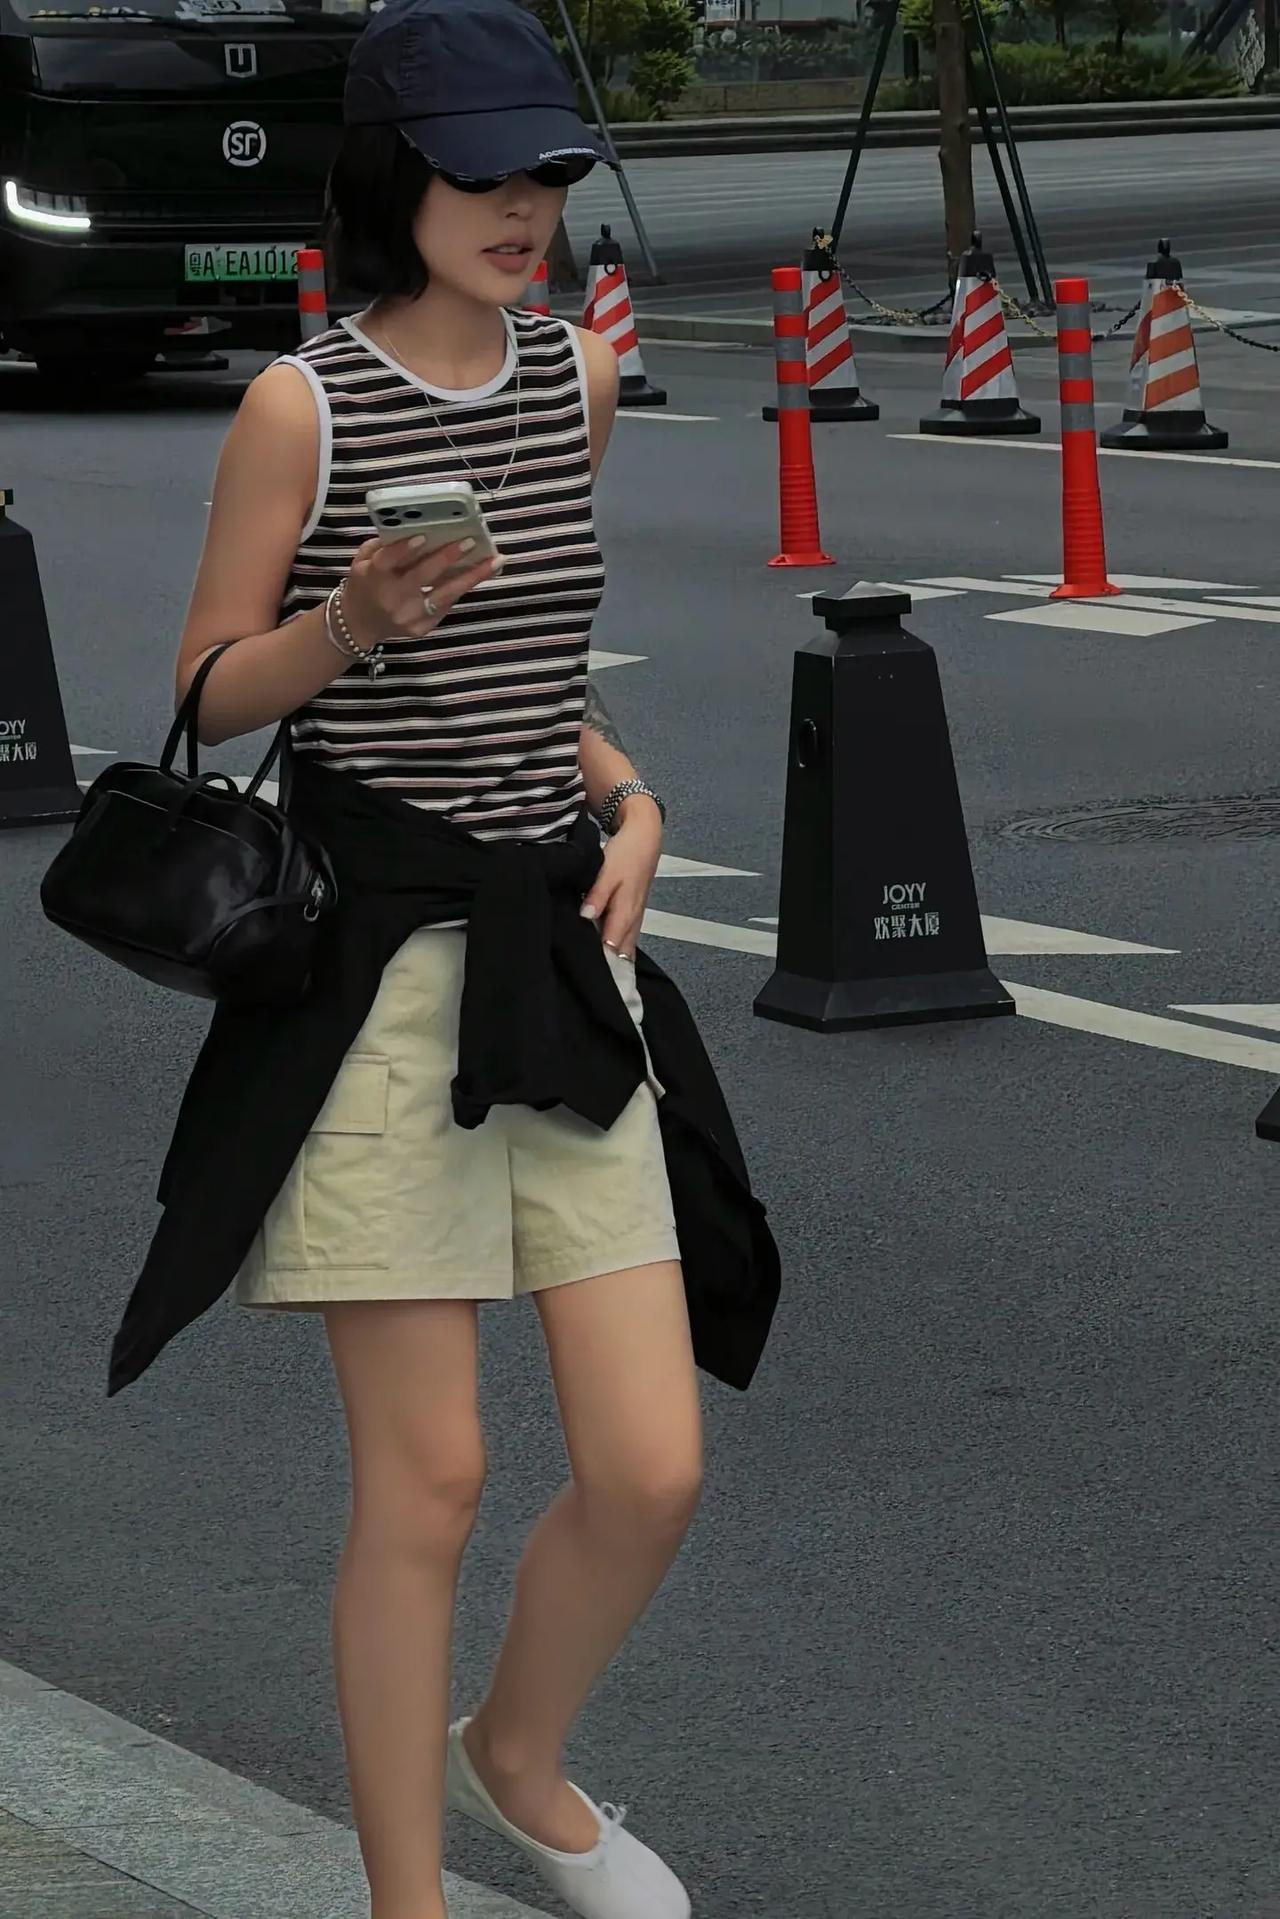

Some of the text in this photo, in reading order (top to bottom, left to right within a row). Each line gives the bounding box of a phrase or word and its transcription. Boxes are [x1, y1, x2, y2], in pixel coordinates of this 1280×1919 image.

[882, 882, 926, 904] JOYY
[874, 911, 940, 940] 欢聚大厦
